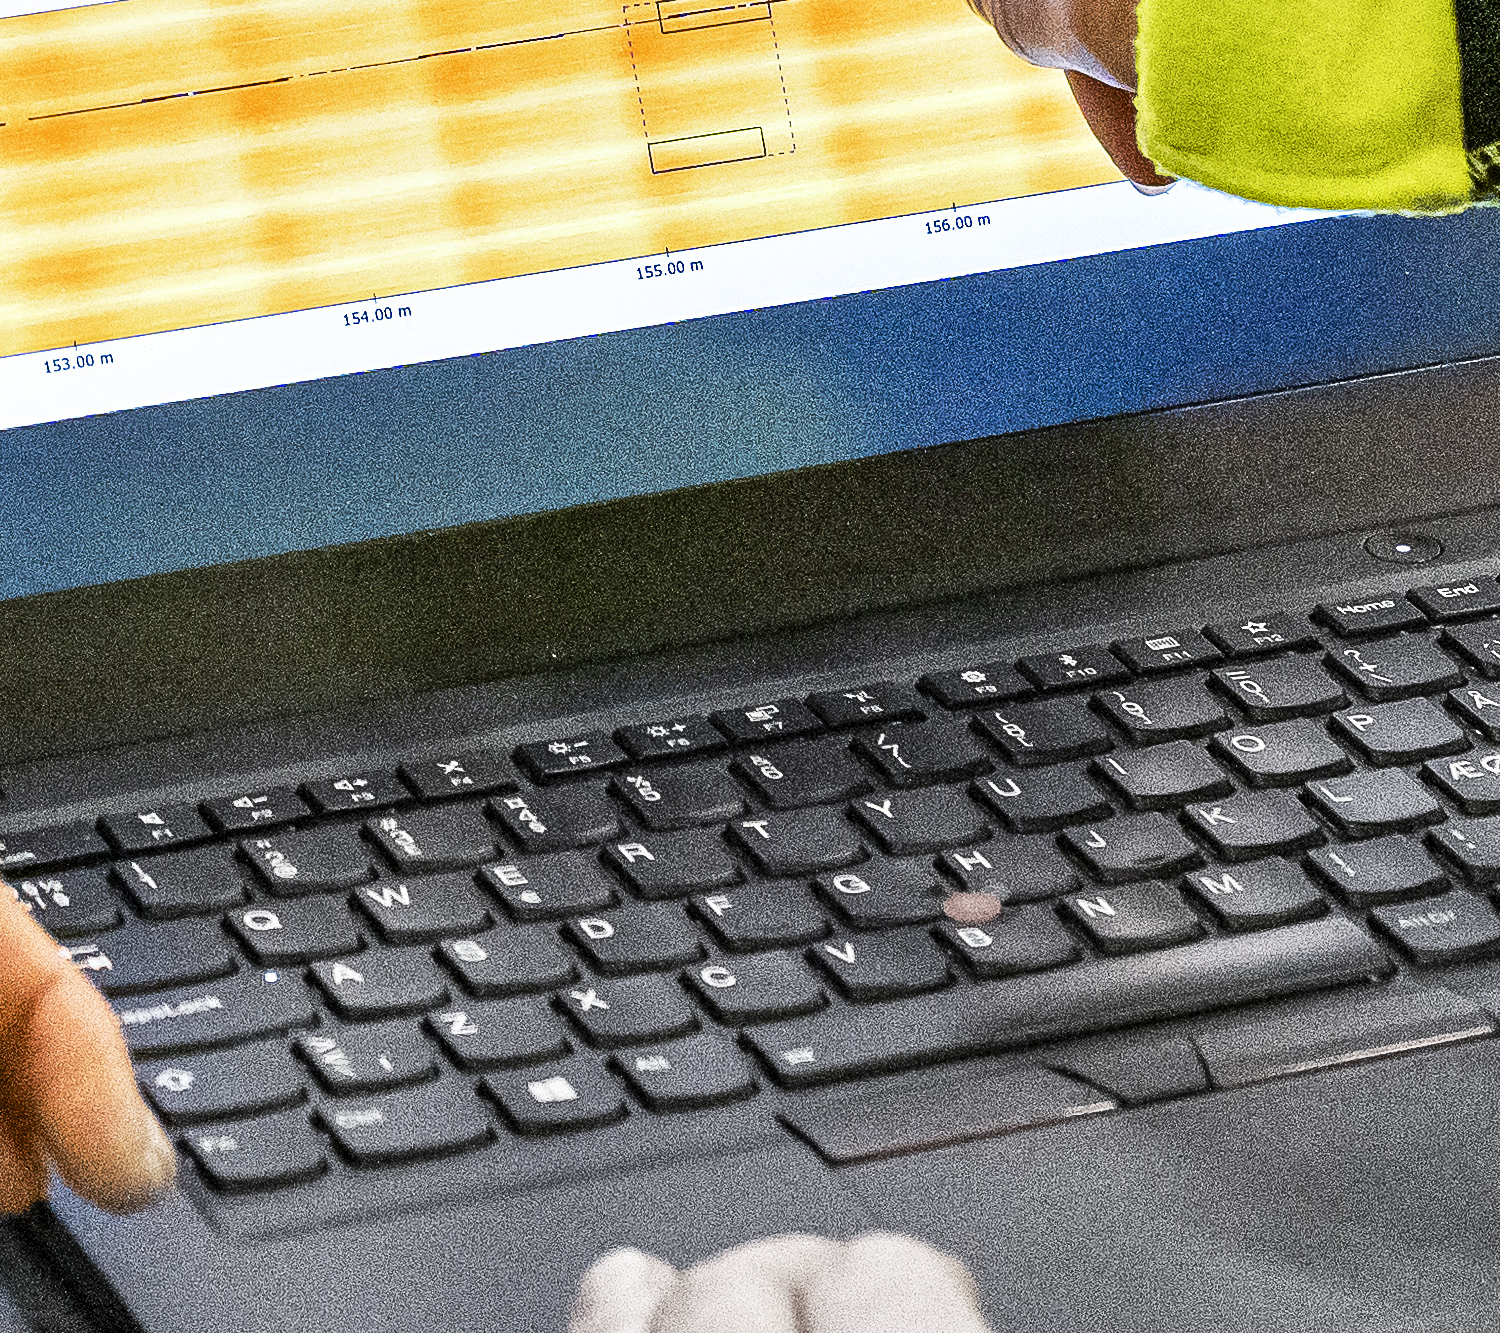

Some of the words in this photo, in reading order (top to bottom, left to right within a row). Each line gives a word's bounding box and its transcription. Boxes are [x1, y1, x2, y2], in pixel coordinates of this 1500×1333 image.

[926, 216, 972, 234] 156.00
[978, 216, 990, 225] m
[637, 261, 684, 279] 155.00
[691, 261, 703, 271] m
[344, 307, 392, 326] 154.00
[399, 307, 411, 317] m
[45, 355, 94, 373] 153.00
[101, 354, 113, 364] m
[1440, 583, 1480, 599] End
[1336, 598, 1396, 616] Home
[1252, 633, 1286, 646] F12
[1065, 667, 1098, 679] F10
[1467, 690, 1500, 710] Å
[1347, 714, 1374, 732] P
[1230, 734, 1266, 754] O
[988, 777, 1022, 798] U
[1320, 785, 1353, 803] L
[864, 798, 894, 819] Y
[1199, 806, 1236, 826] K
[743, 819, 770, 839] T
[1085, 829, 1107, 849] J
[952, 850, 993, 871] H
[493, 865, 529, 885] E
[832, 874, 871, 894] G
[1199, 873, 1245, 895] M
[366, 884, 411, 908] W
[704, 894, 733, 916] F
[1078, 895, 1115, 917] N
[243, 909, 283, 931] Q
[823, 942, 858, 964] V
[569, 987, 609, 1012] X
